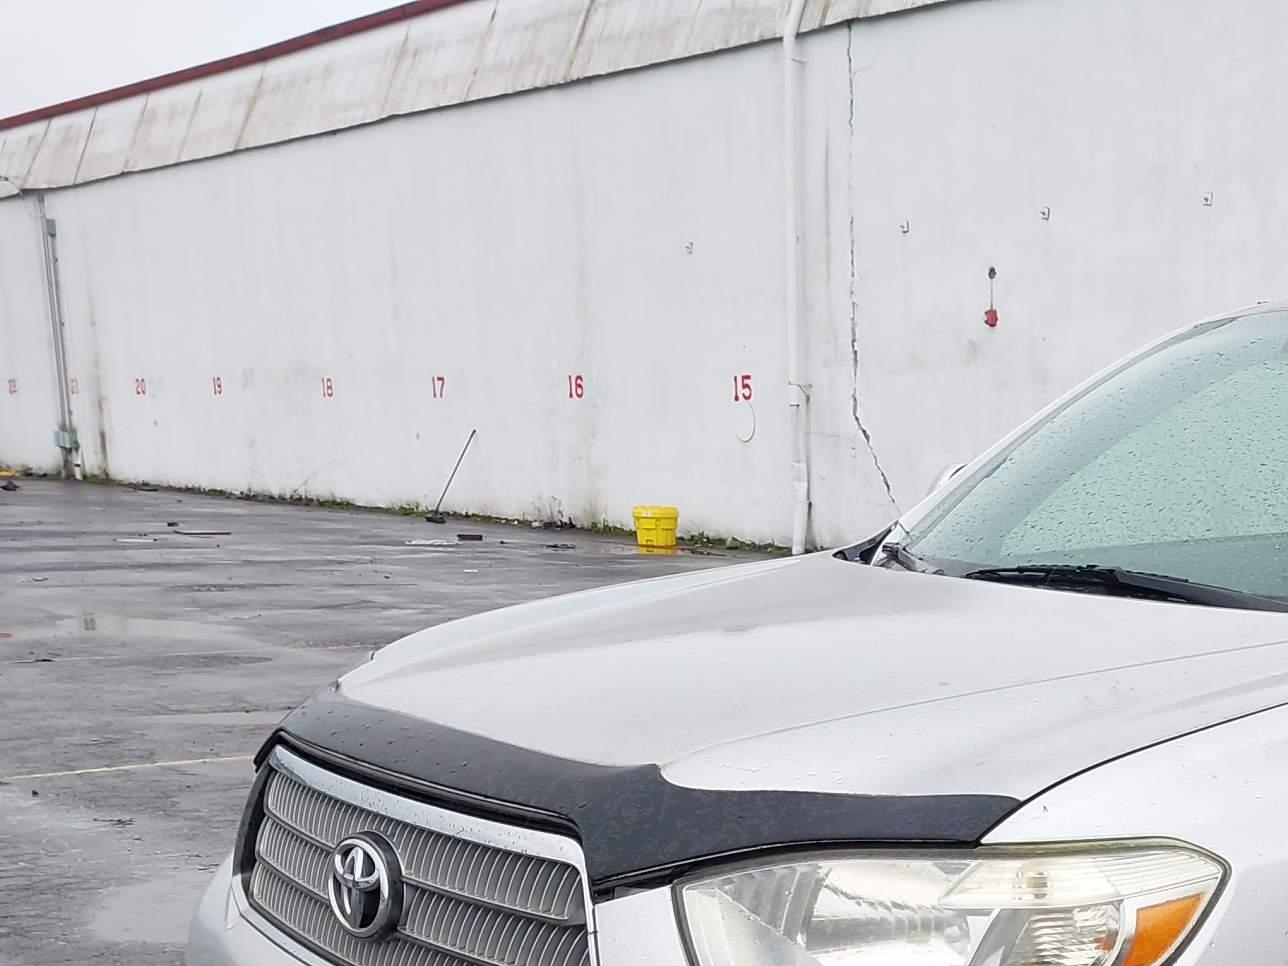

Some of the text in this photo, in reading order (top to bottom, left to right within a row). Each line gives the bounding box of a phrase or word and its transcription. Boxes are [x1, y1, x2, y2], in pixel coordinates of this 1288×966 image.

[321, 377, 333, 397] 18
[432, 376, 445, 399] 17
[568, 374, 584, 399] 16
[733, 374, 752, 401] 15
